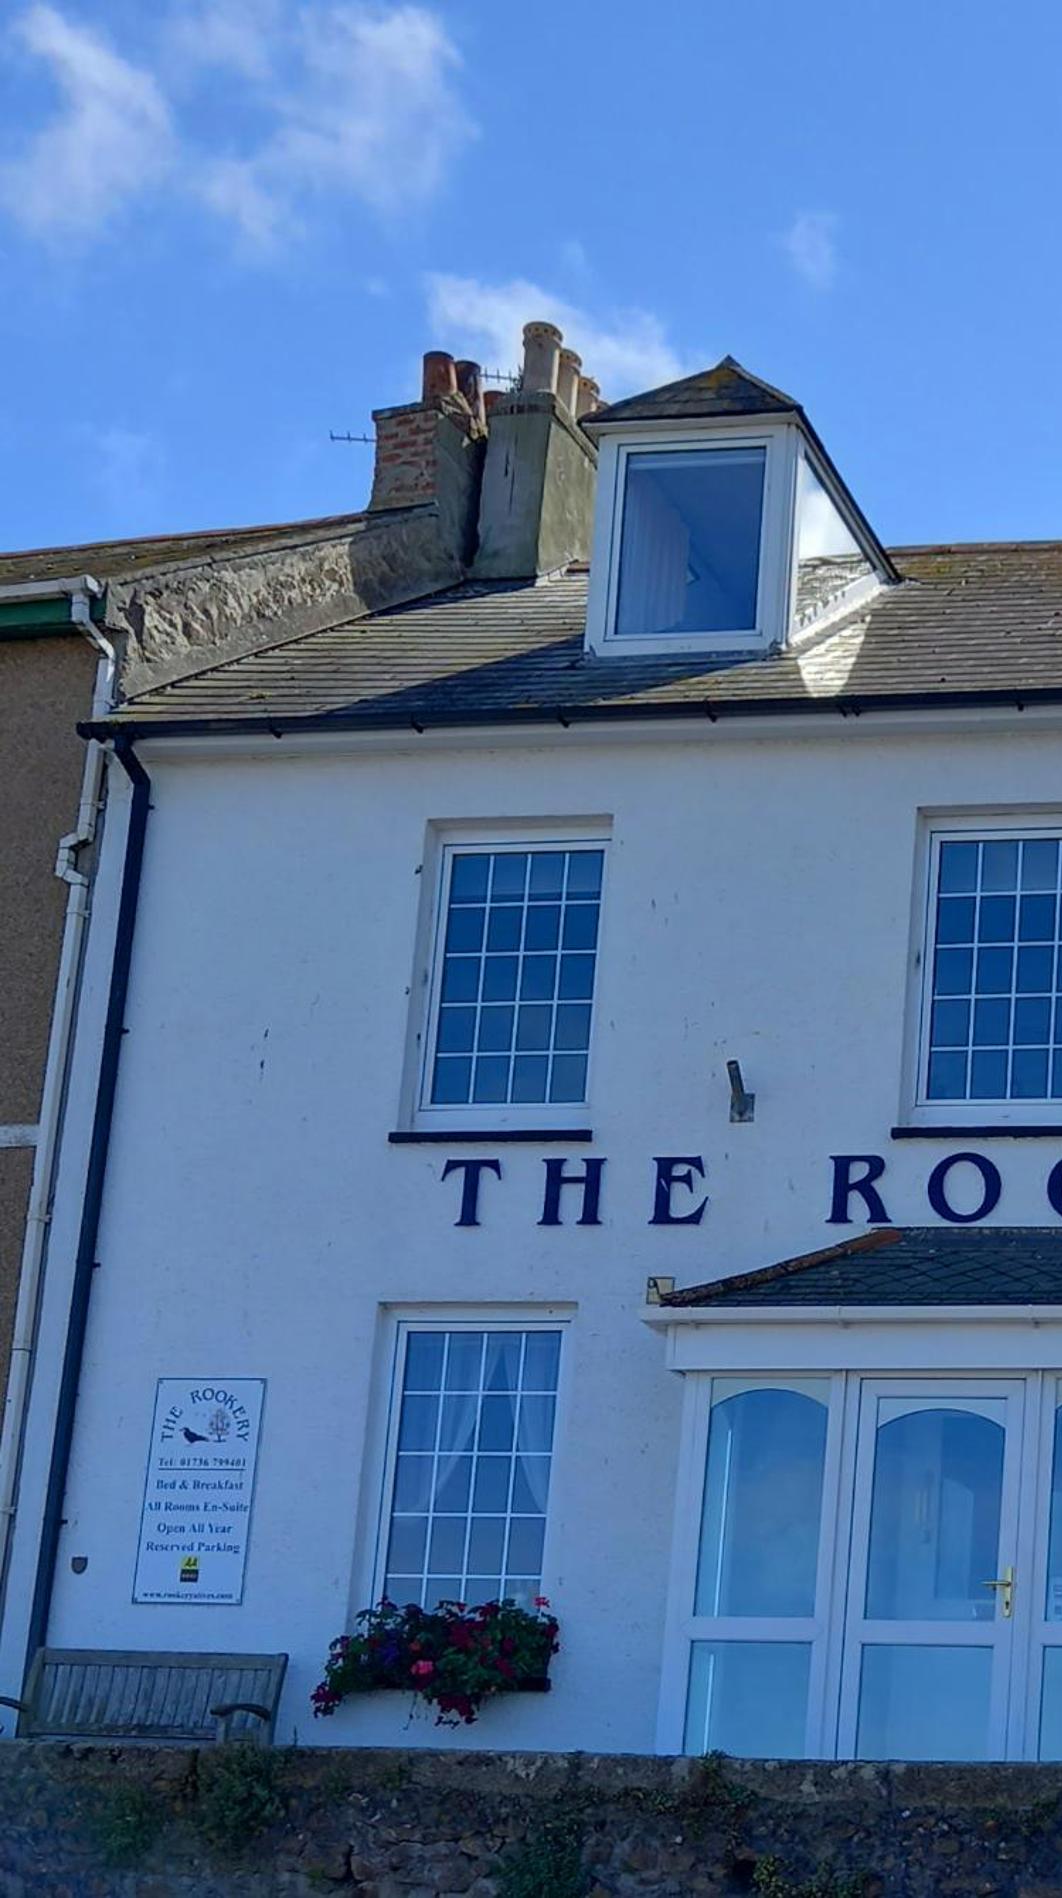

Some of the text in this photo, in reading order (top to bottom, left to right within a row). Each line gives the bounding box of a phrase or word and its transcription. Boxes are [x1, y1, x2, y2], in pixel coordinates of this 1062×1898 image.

[440, 1155, 710, 1226] THE
[160, 1387, 250, 1443] THE ROOKERY
[156, 1479, 244, 1490] Bed & Breakfast
[147, 1501, 249, 1512] All Rooms En-Suite
[157, 1522, 233, 1535] Open All Year
[145, 1541, 241, 1554] Reserved Parking
